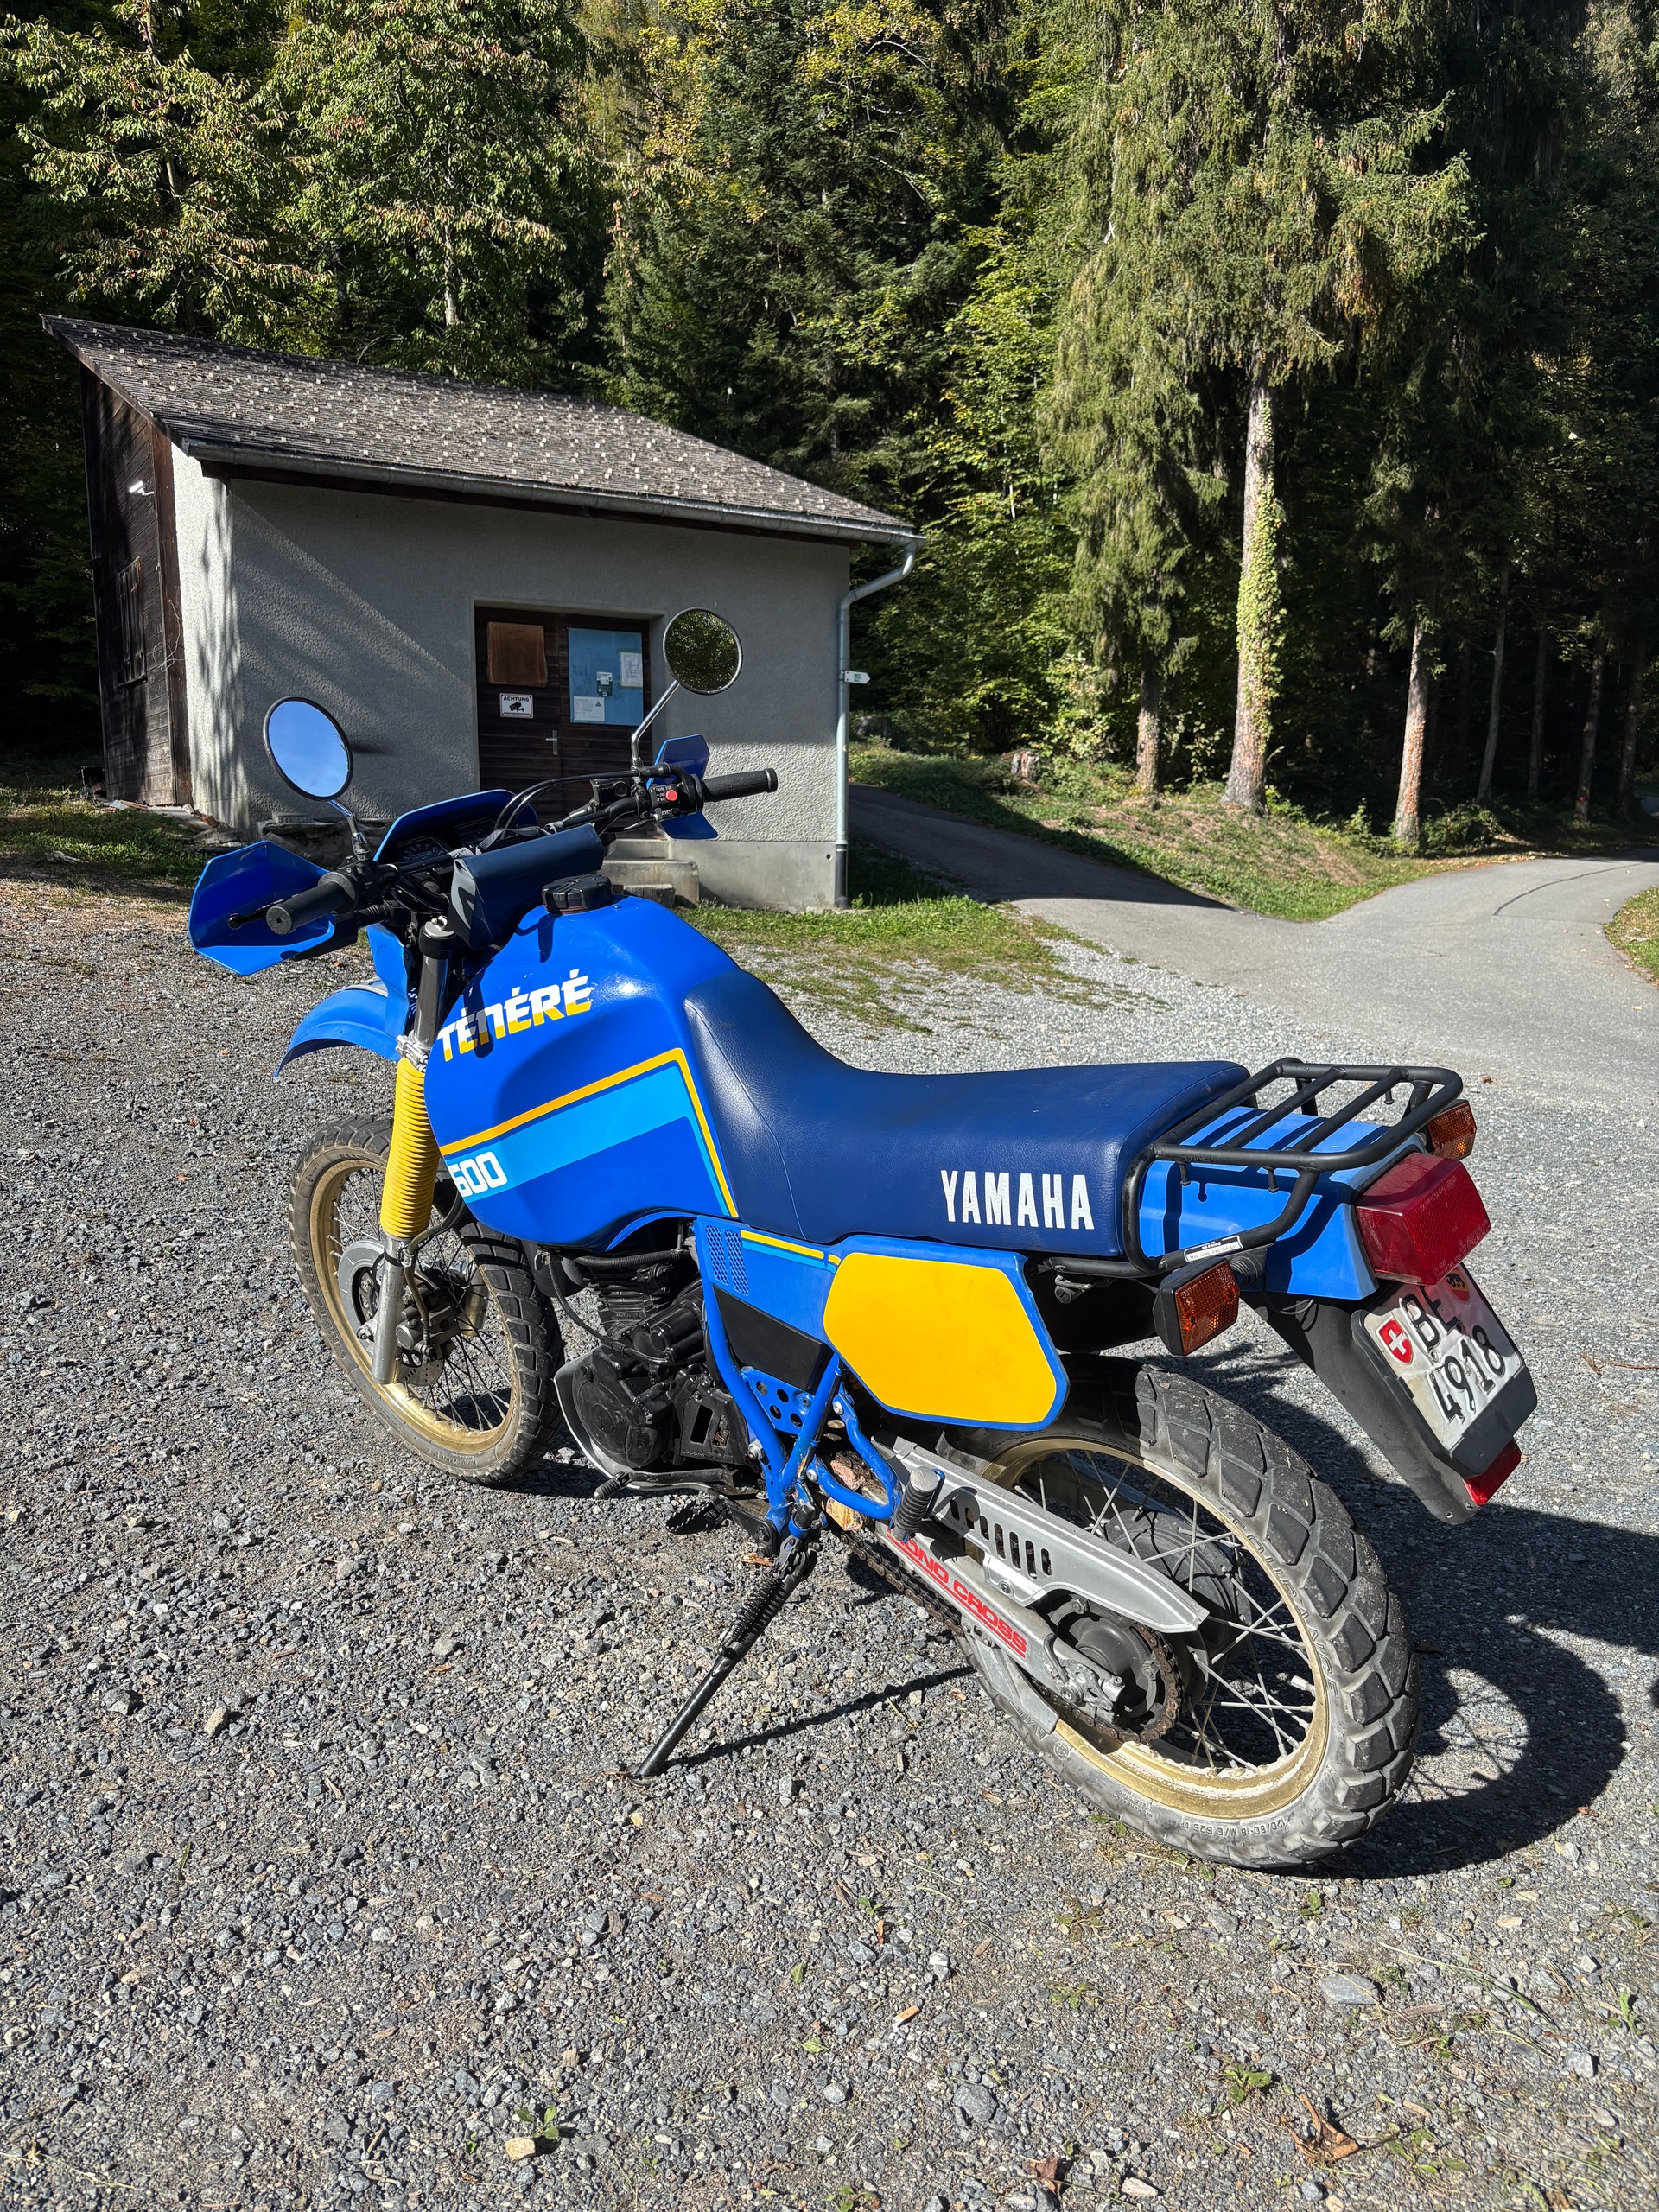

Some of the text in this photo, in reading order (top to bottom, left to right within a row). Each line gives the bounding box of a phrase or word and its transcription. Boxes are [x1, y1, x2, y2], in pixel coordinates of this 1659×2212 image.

[436, 969, 593, 1062] TÉNÉRÉ
[447, 1151, 508, 1198] 600
[940, 1169, 1095, 1230] YAMAHA
[1401, 1285, 1461, 1351] BE
[1428, 1325, 1506, 1424] 4918
[888, 1526, 1027, 1653] ONO CROSS
[1241, 1818, 1286, 1837] 120/80-18
